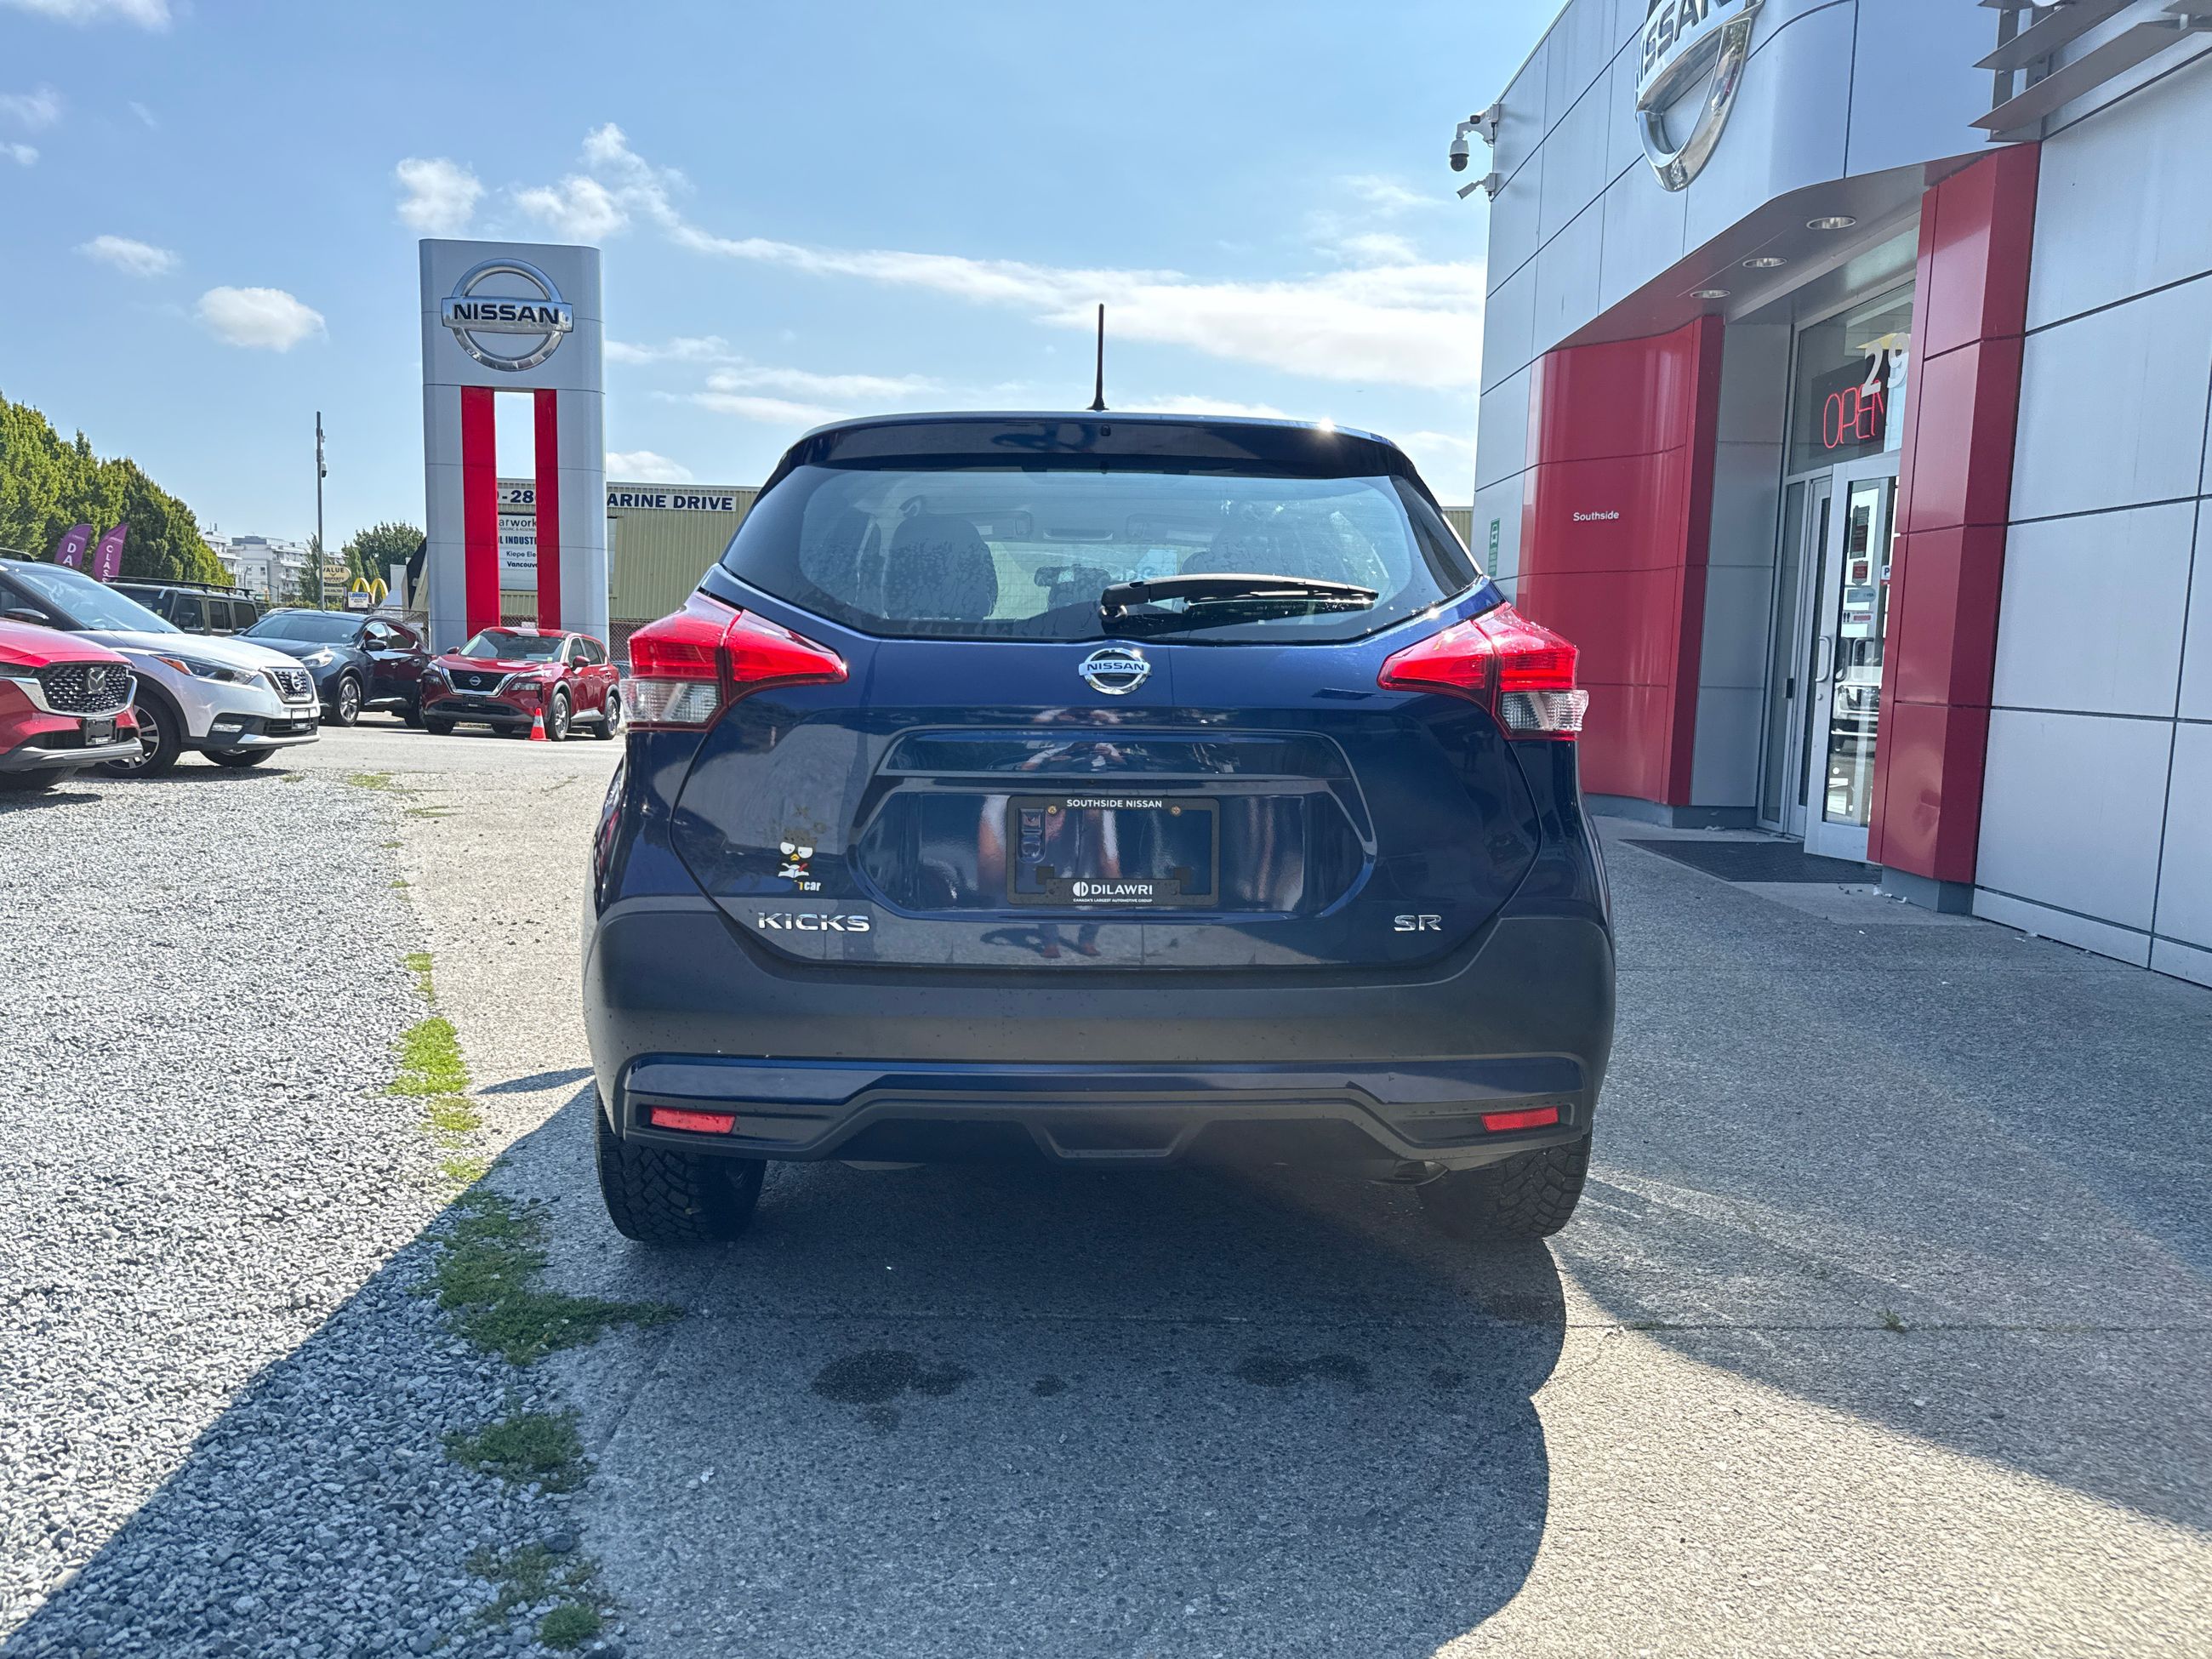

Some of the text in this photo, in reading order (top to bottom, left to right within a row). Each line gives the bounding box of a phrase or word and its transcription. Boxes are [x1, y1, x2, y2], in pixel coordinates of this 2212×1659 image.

[453, 304, 559, 324] NISSAN
[1861, 332, 1910, 398] 29
[607, 493, 733, 510] ARINE DRIVE
[1573, 511, 1620, 522] Southside
[1086, 662, 1144, 670] NISSAN
[1066, 799, 1123, 807] SOUTHSIDE
[1091, 884, 1153, 895] DILAWRI
[757, 912, 870, 932] KICKS
[1394, 915, 1442, 932] SR
